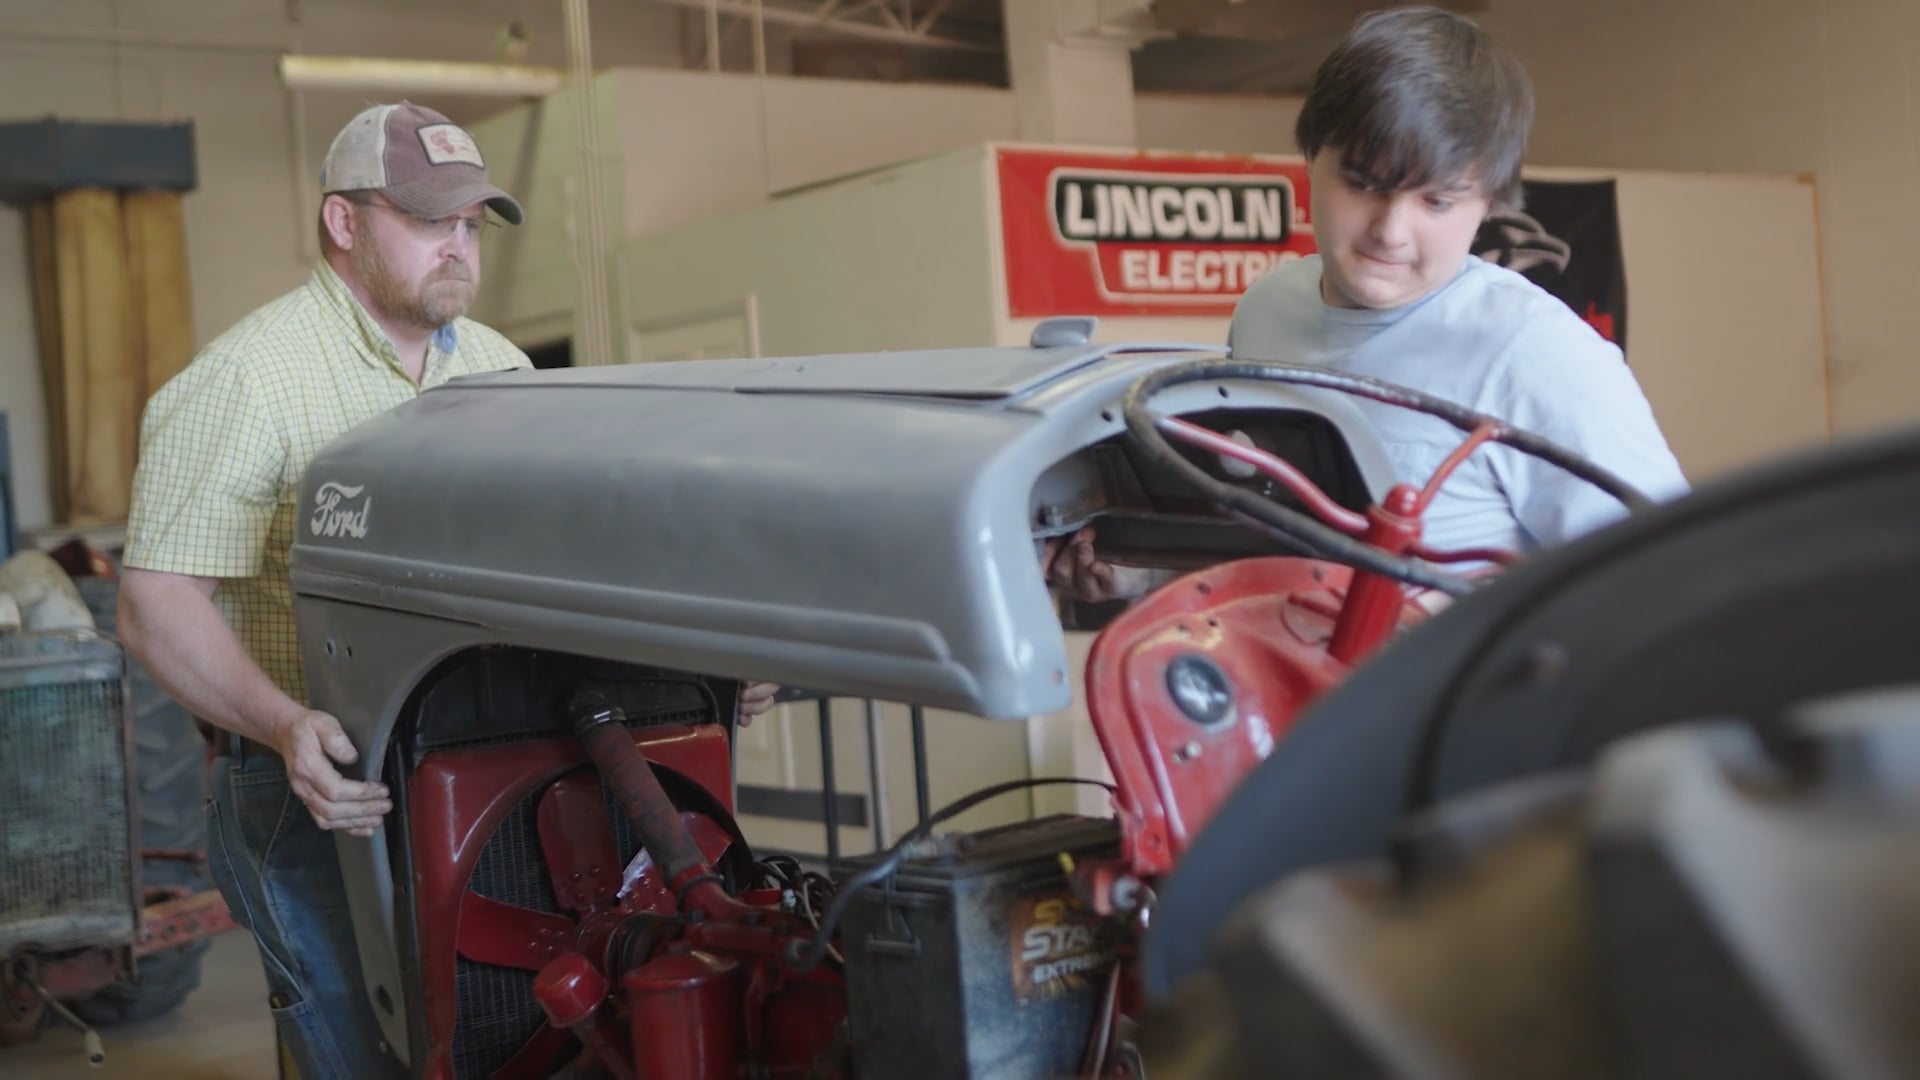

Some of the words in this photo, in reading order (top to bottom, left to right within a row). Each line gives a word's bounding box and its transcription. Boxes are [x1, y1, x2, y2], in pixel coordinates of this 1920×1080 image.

[1064, 182, 1282, 240] LINCOLN
[1120, 249, 1299, 289] ELECTRI
[311, 481, 371, 538] Ford
